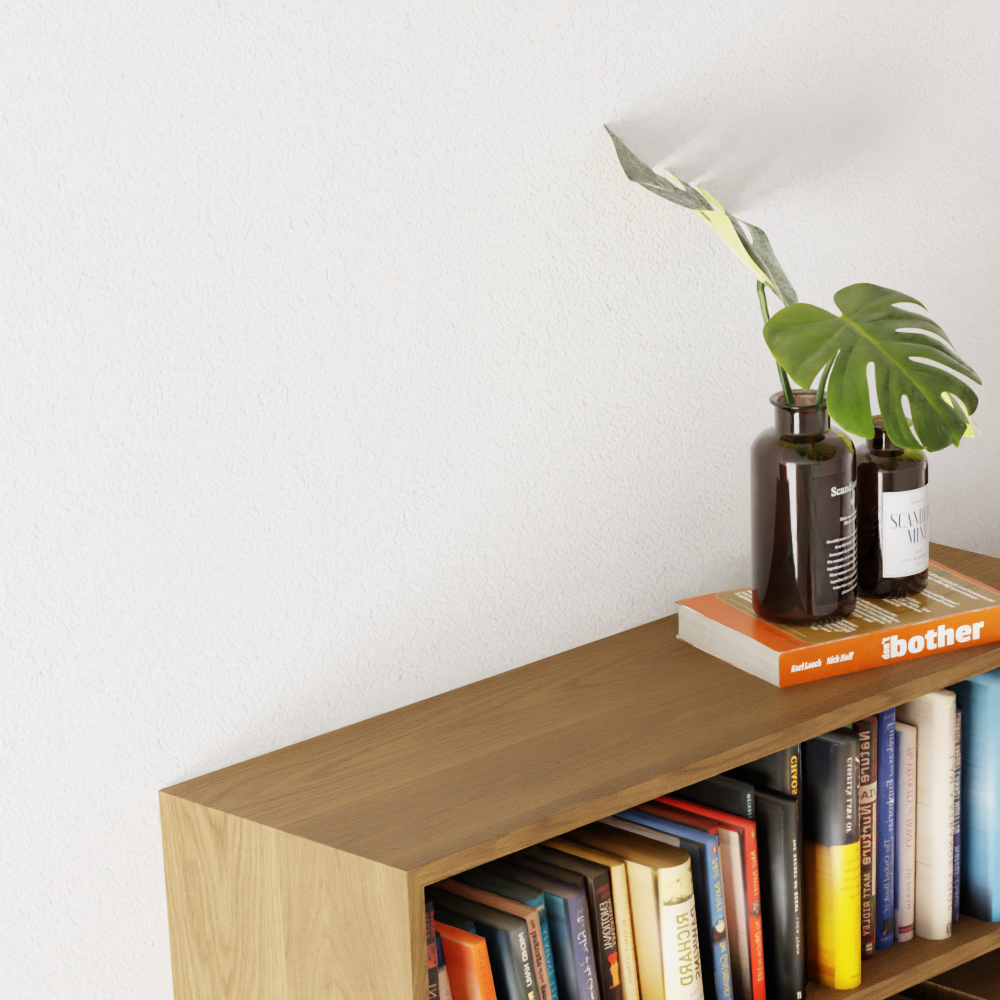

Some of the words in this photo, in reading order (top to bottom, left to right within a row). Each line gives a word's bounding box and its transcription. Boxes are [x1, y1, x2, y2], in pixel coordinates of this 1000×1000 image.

[881, 636, 890, 660] don't
[890, 621, 984, 659] bother
[826, 656, 840, 665] Nick
[840, 651, 854, 662] Hoff
